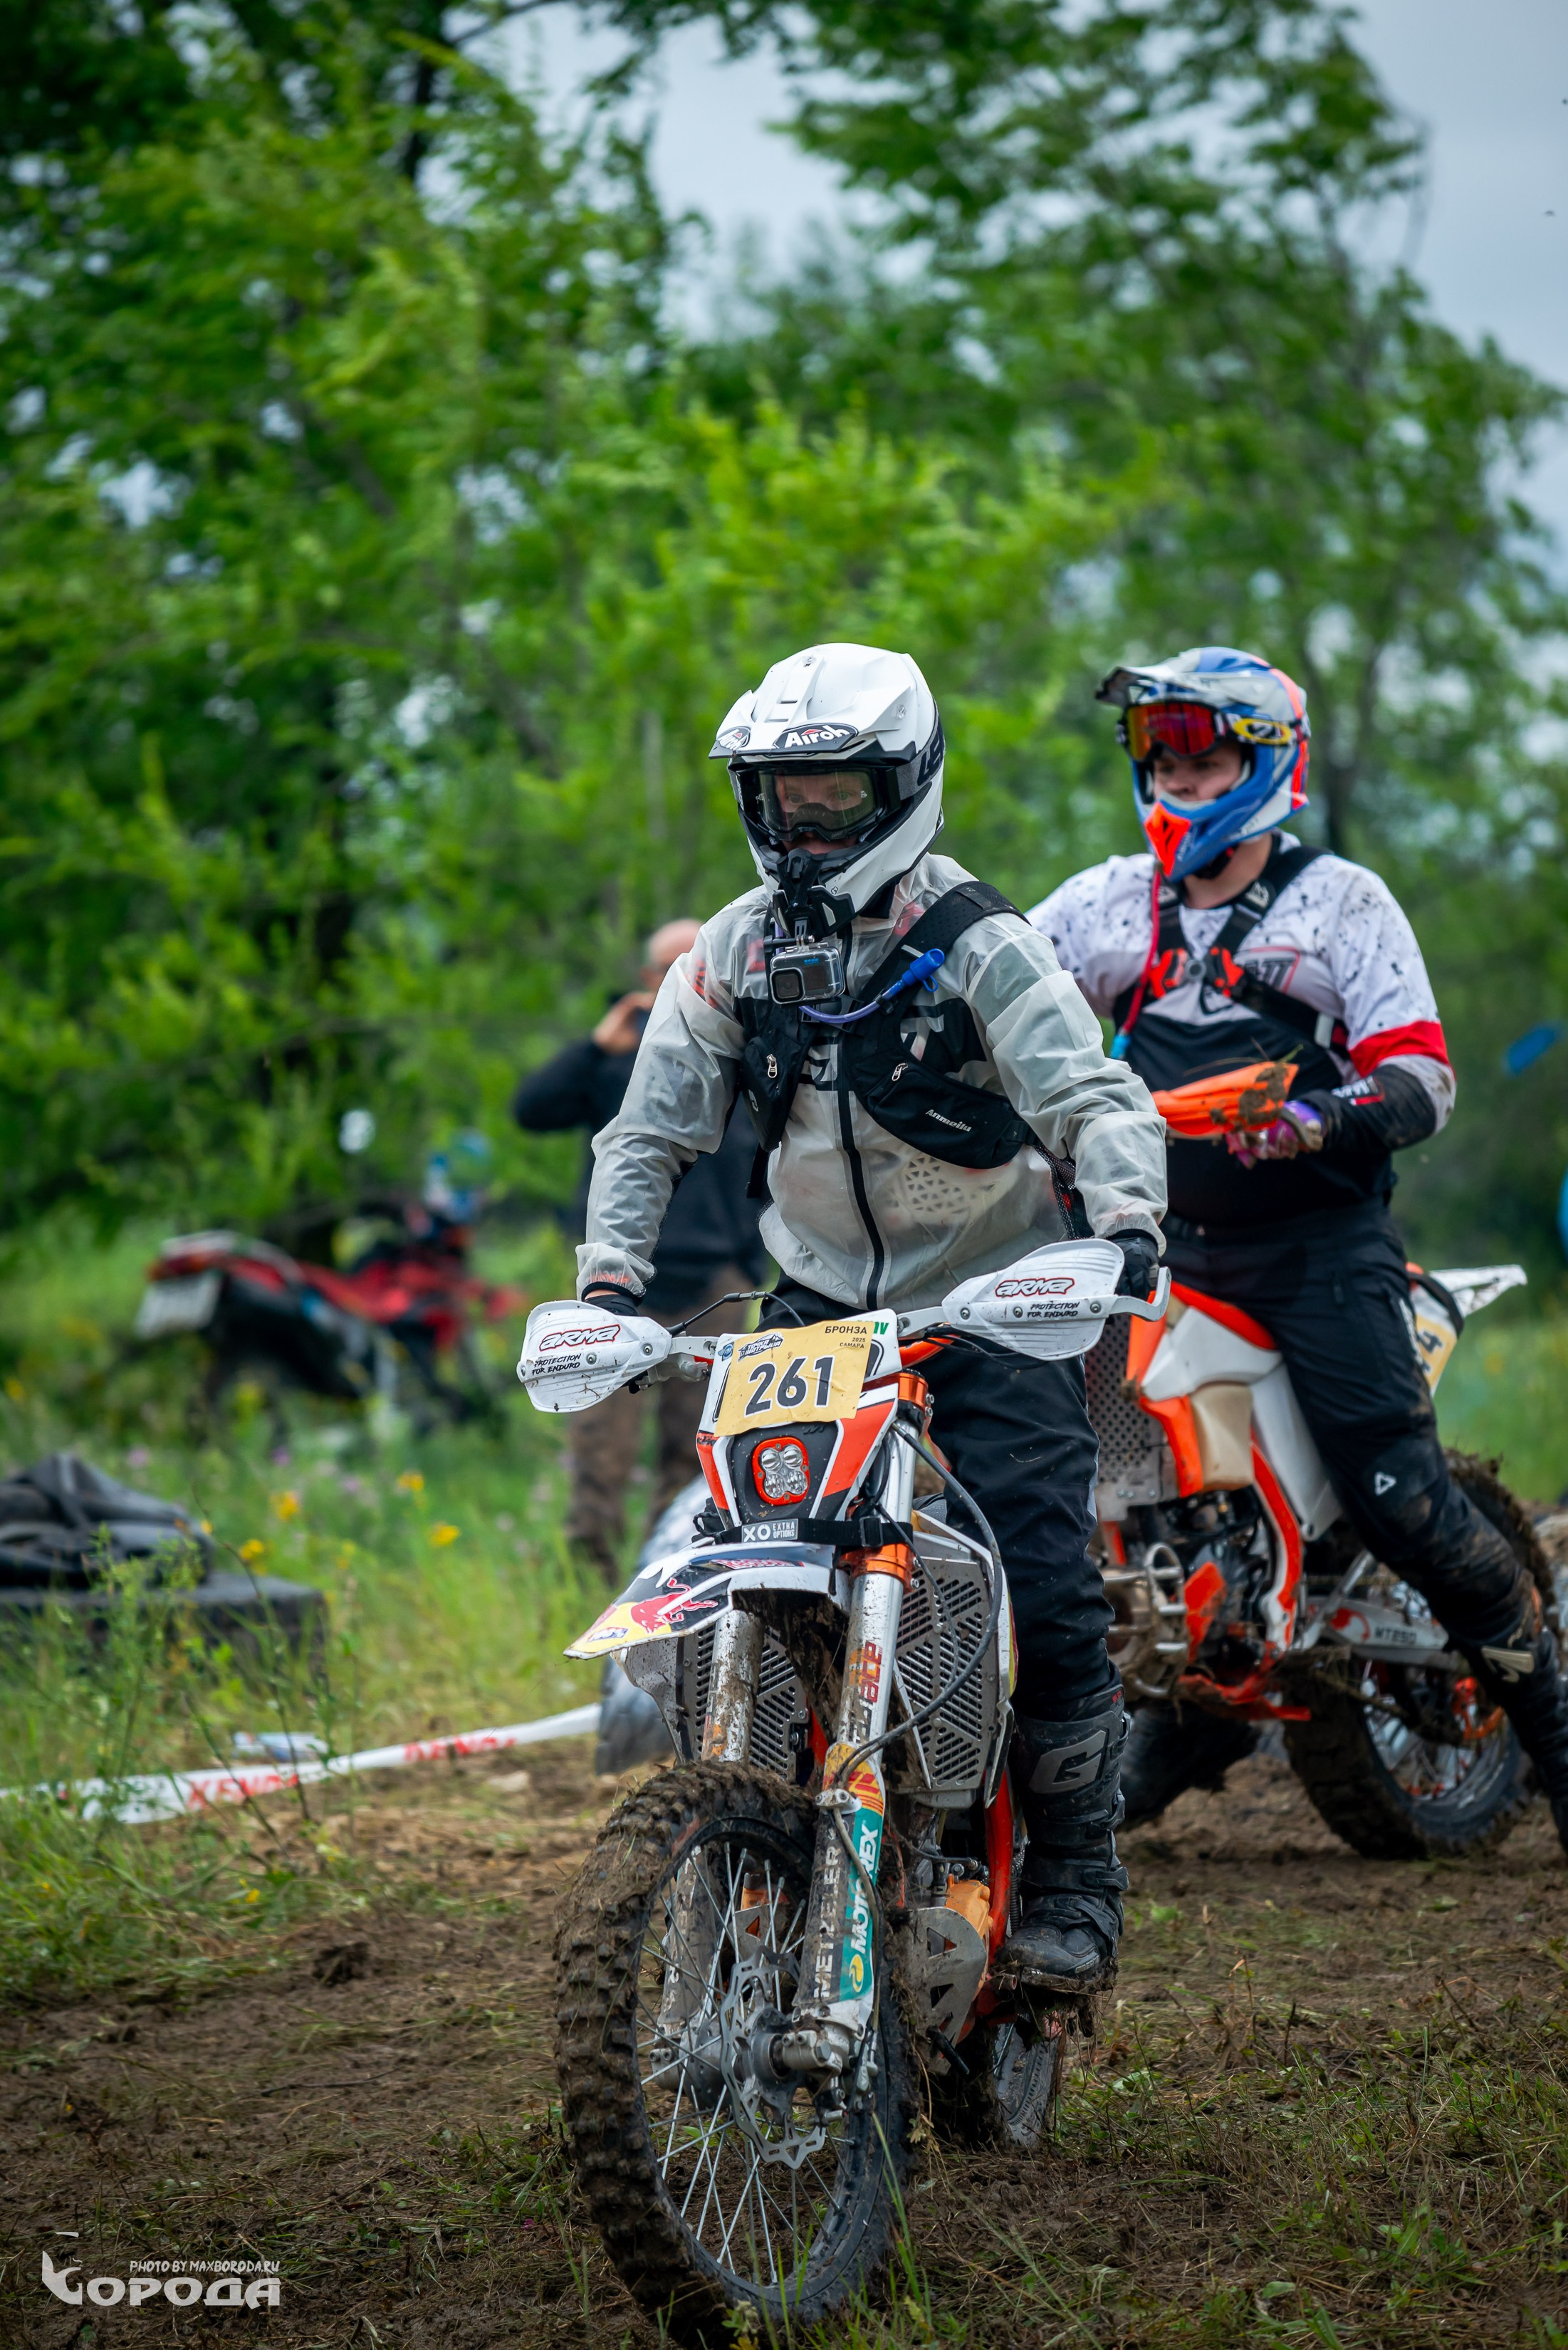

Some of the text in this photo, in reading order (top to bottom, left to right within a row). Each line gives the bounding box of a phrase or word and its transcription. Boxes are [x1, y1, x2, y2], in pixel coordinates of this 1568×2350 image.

[785, 725, 850, 748] Airoh
[925, 1109, 972, 1132] Anmeilu
[1030, 1302, 1080, 1310] PROTECTION
[825, 1325, 867, 1335] БРОНЗА
[534, 1353, 582, 1368] PROTECTION
[531, 1362, 580, 1376] FOR ENDURO
[744, 1354, 836, 1417] 261
[743, 1524, 770, 1542] XO
[773, 1530, 795, 1539] OPTIONS
